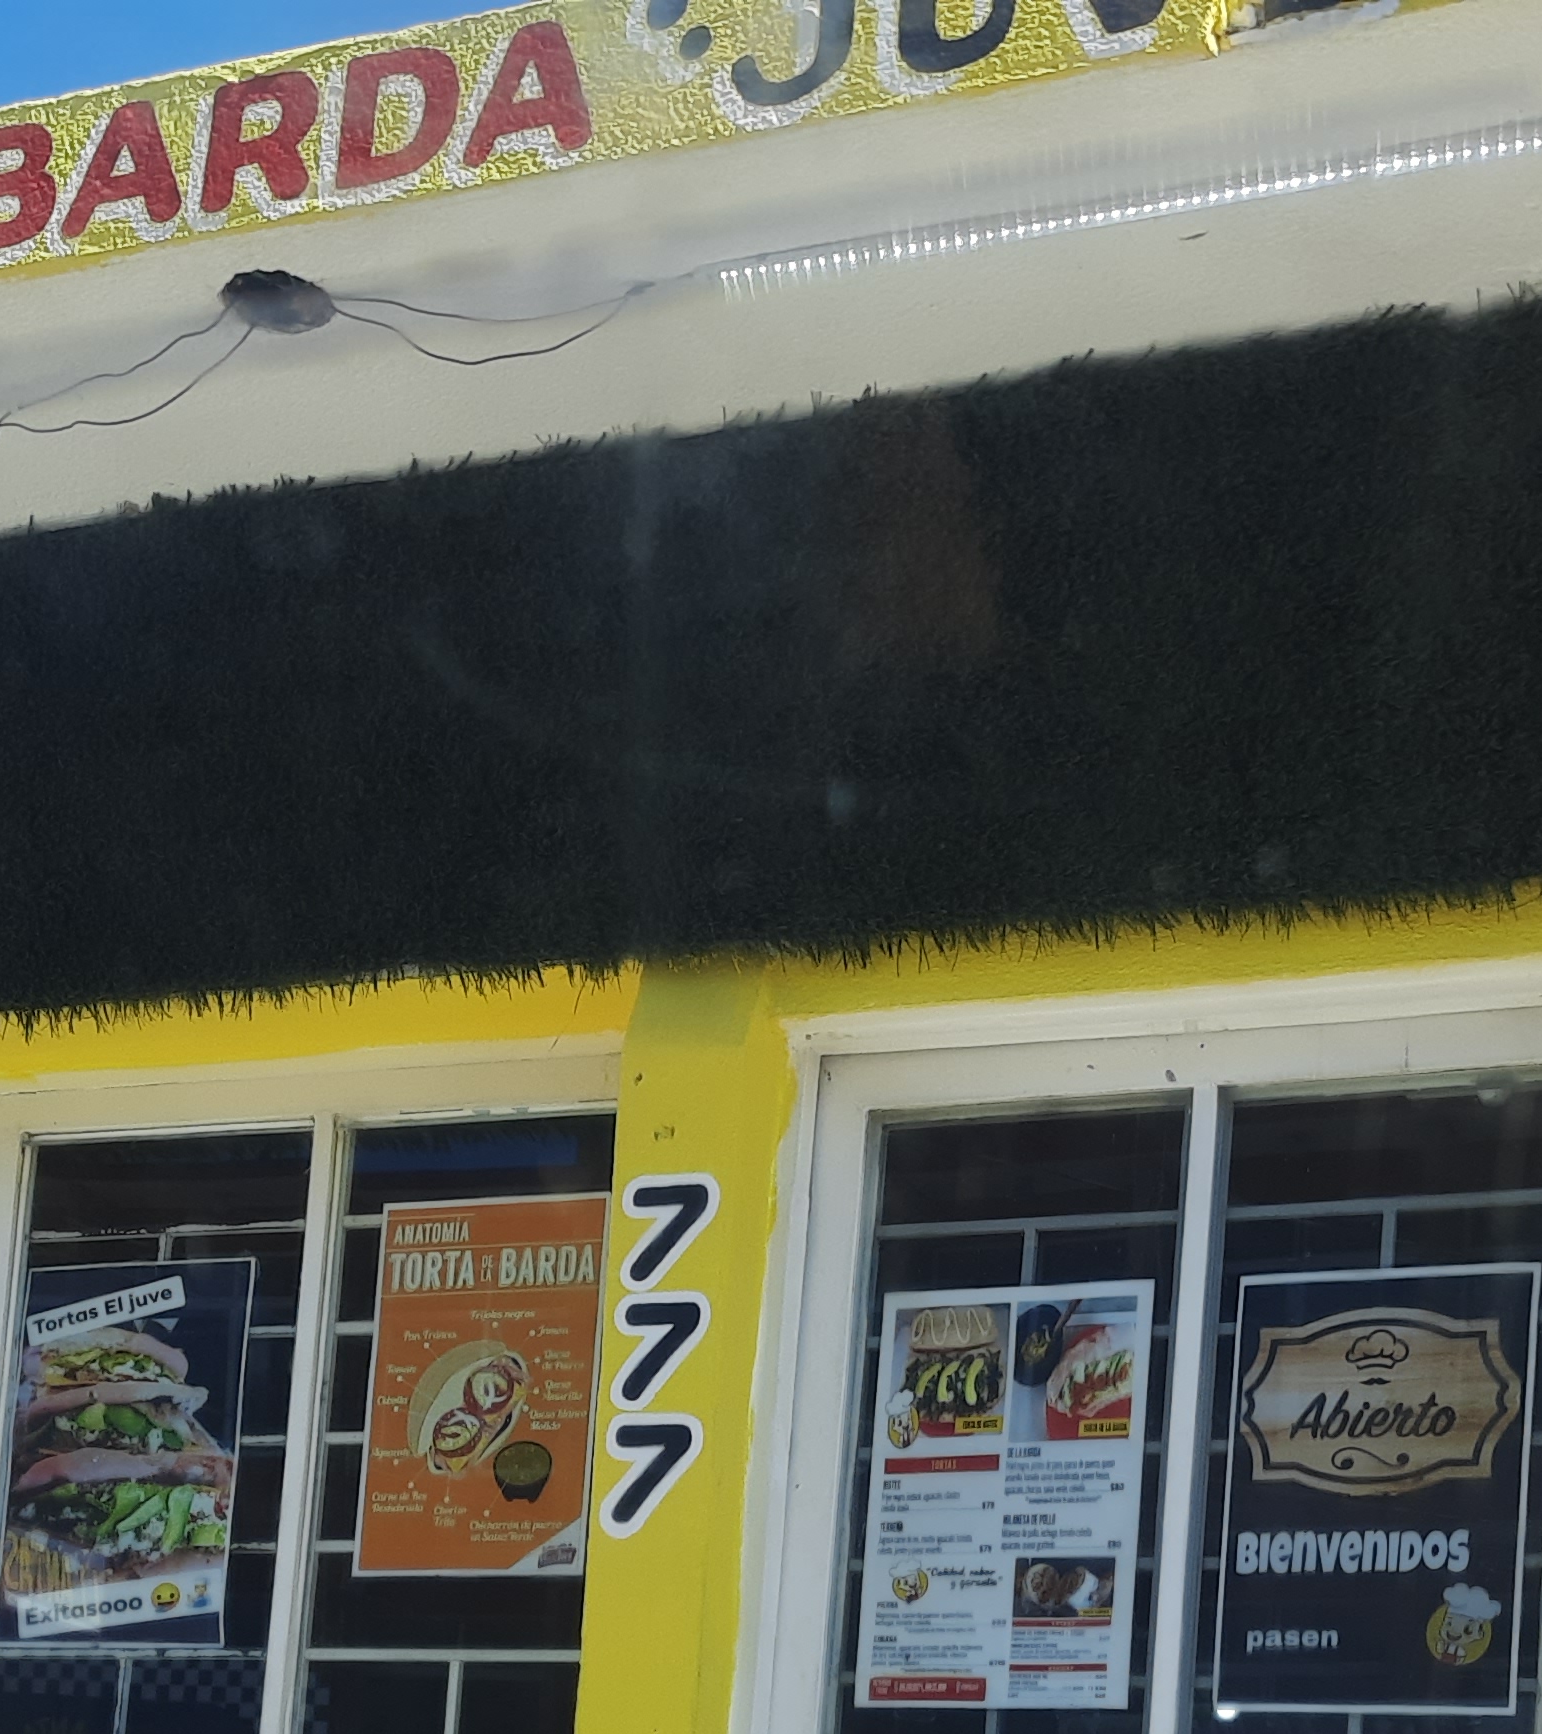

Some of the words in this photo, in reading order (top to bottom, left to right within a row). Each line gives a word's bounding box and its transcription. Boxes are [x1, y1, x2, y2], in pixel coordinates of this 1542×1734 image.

[393, 1217, 470, 1246] ANATOMÍA
[389, 1250, 475, 1293] TORTA
[480, 1268, 492, 1283] LA
[482, 1254, 493, 1269] DE
[498, 1243, 595, 1288] BARDA
[32, 1307, 98, 1336] Tortas
[105, 1298, 124, 1315] El
[128, 1285, 173, 1315] juve
[1288, 1389, 1457, 1441] Abierto
[24, 1596, 143, 1627] Exitasooo
[1245, 1626, 1339, 1655] pasen
